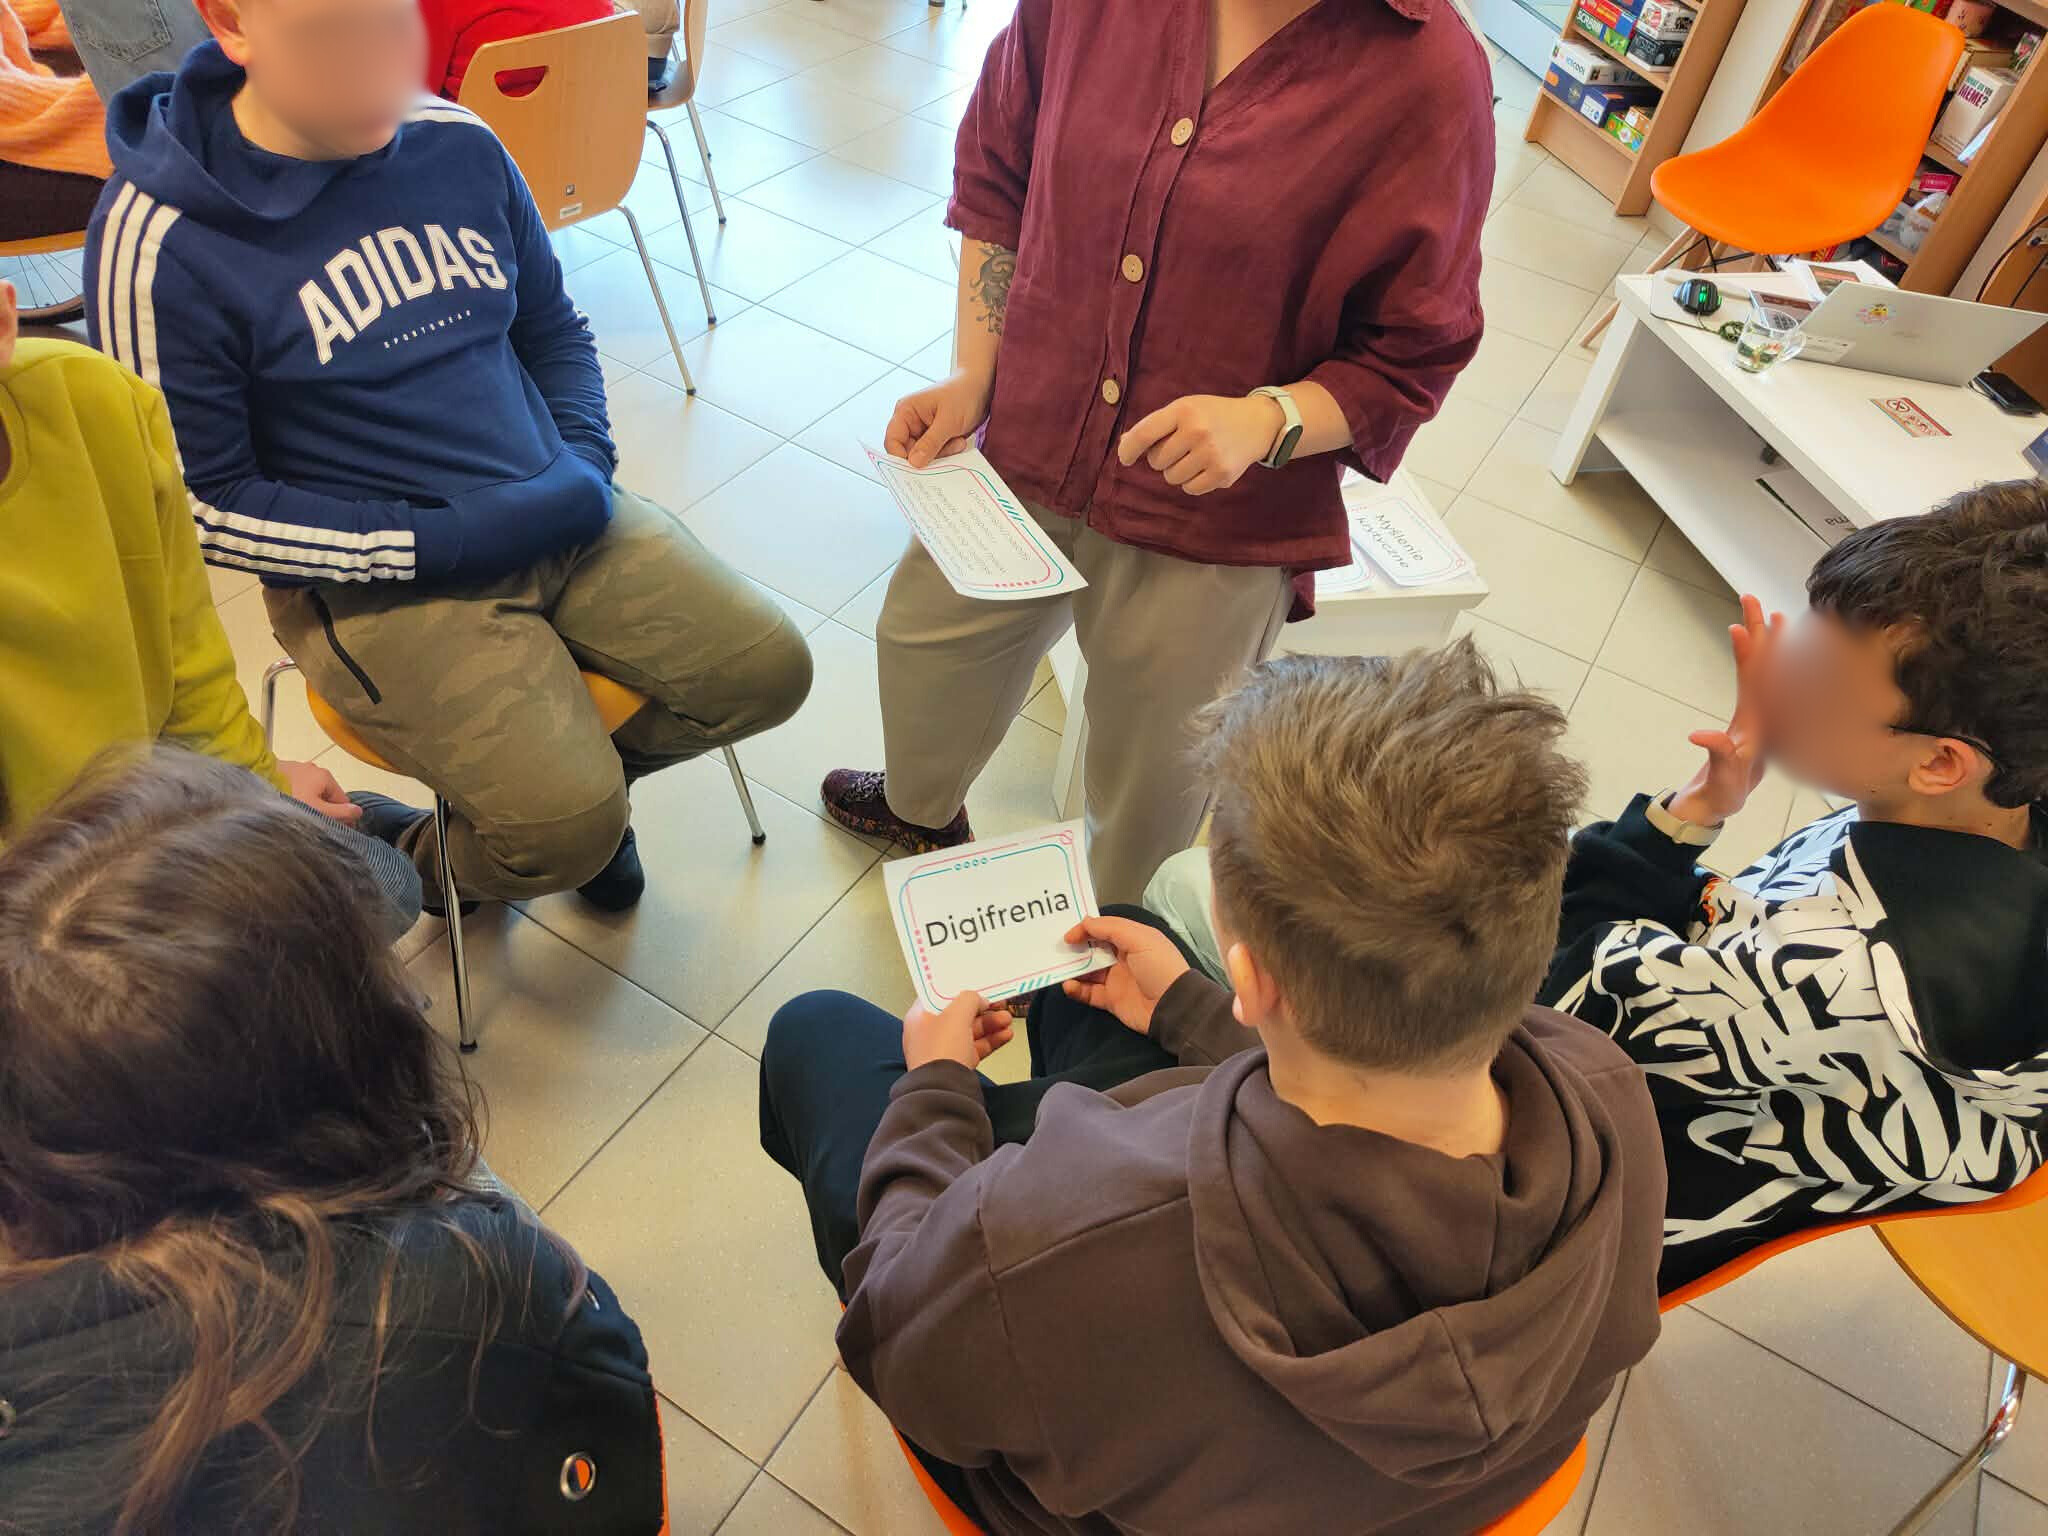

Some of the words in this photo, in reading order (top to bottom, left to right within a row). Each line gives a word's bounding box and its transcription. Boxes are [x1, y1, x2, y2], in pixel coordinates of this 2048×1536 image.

[1958, 84, 1988, 108] MEME?
[1967, 76, 1978, 88] WHAT
[1983, 87, 1993, 96] YOU
[298, 224, 508, 365] ADIDAS
[383, 308, 472, 349] SPORTSWEAR
[925, 889, 1070, 947] Digifrenia
